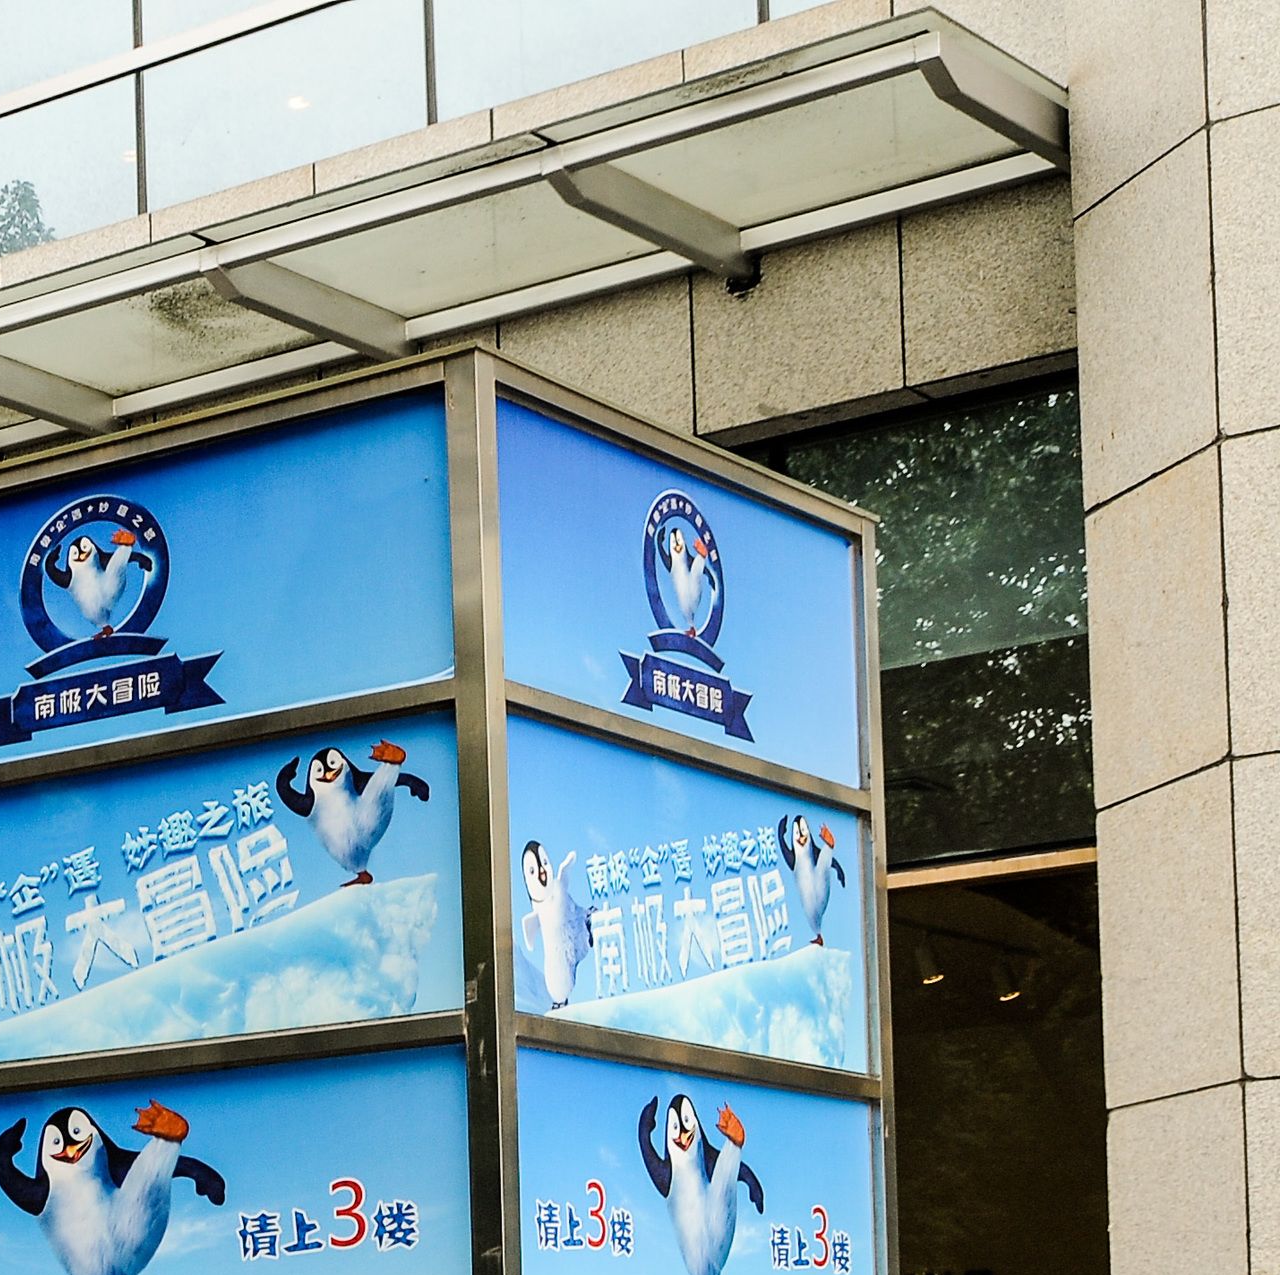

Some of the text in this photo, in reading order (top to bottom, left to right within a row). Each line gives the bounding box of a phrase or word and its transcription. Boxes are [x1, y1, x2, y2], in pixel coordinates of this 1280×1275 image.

[34, 672, 161, 720] 南极大冒险
[653, 669, 723, 713] 南极大冒险
[121, 780, 275, 872] 妙趣之旅
[702, 826, 778, 877] 妙趣之旅
[591, 869, 792, 999] 南极大冒险
[237, 1178, 420, 1261] 请上3楼
[536, 1179, 634, 1257] 请上3楼
[771, 1206, 852, 1274] 请上3楼
